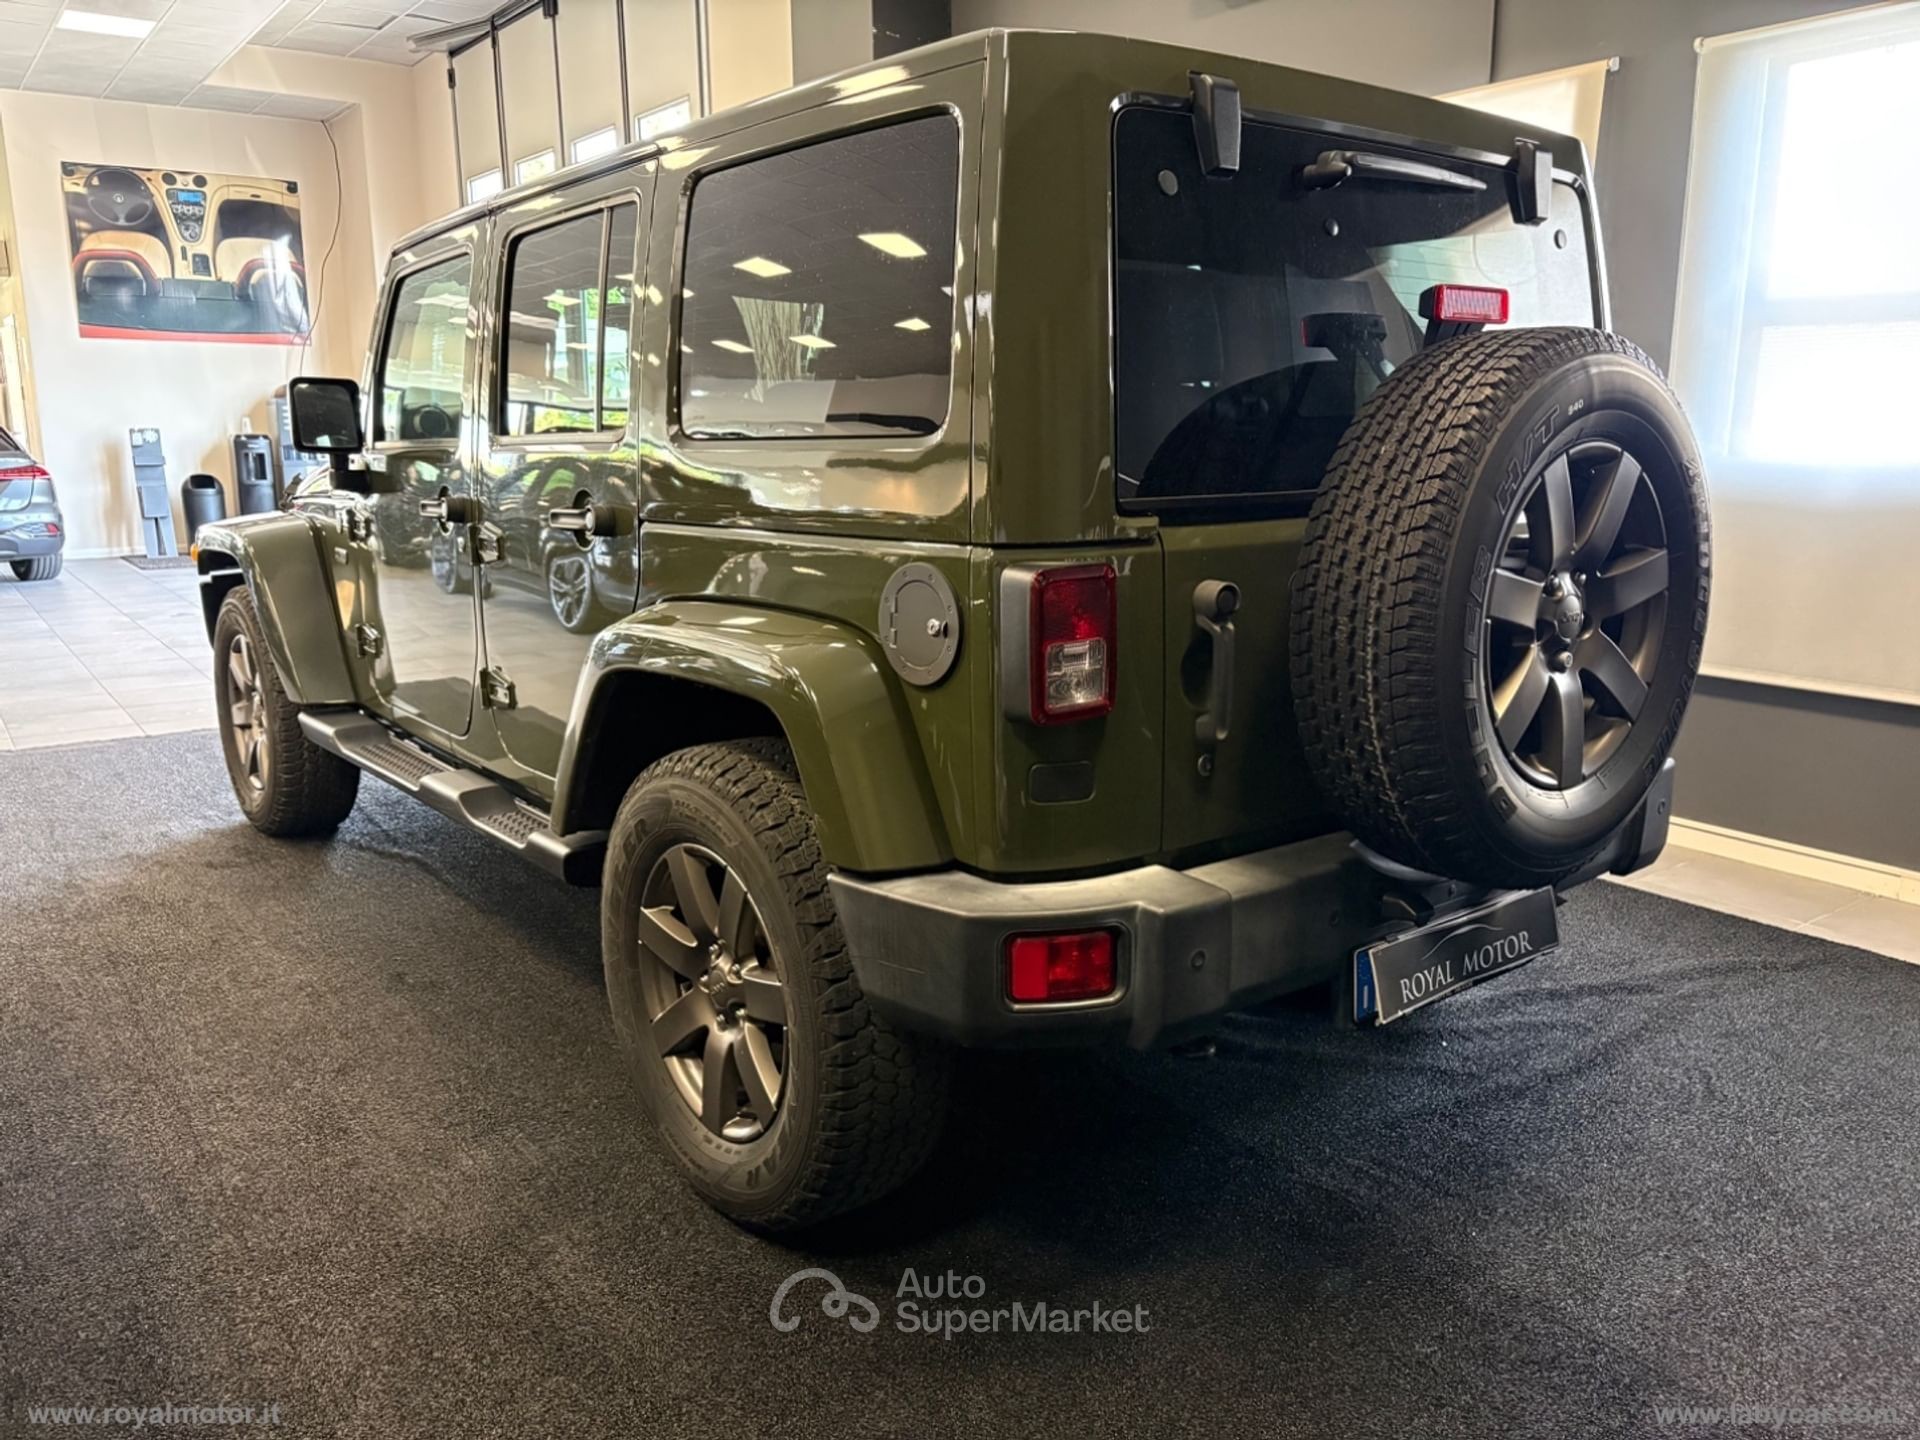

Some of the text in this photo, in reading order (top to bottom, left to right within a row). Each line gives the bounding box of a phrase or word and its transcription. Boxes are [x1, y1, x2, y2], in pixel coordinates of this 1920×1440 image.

[1495, 404, 1560, 516] H/T
[1400, 930, 1533, 1004] ROYAL MOTOR
